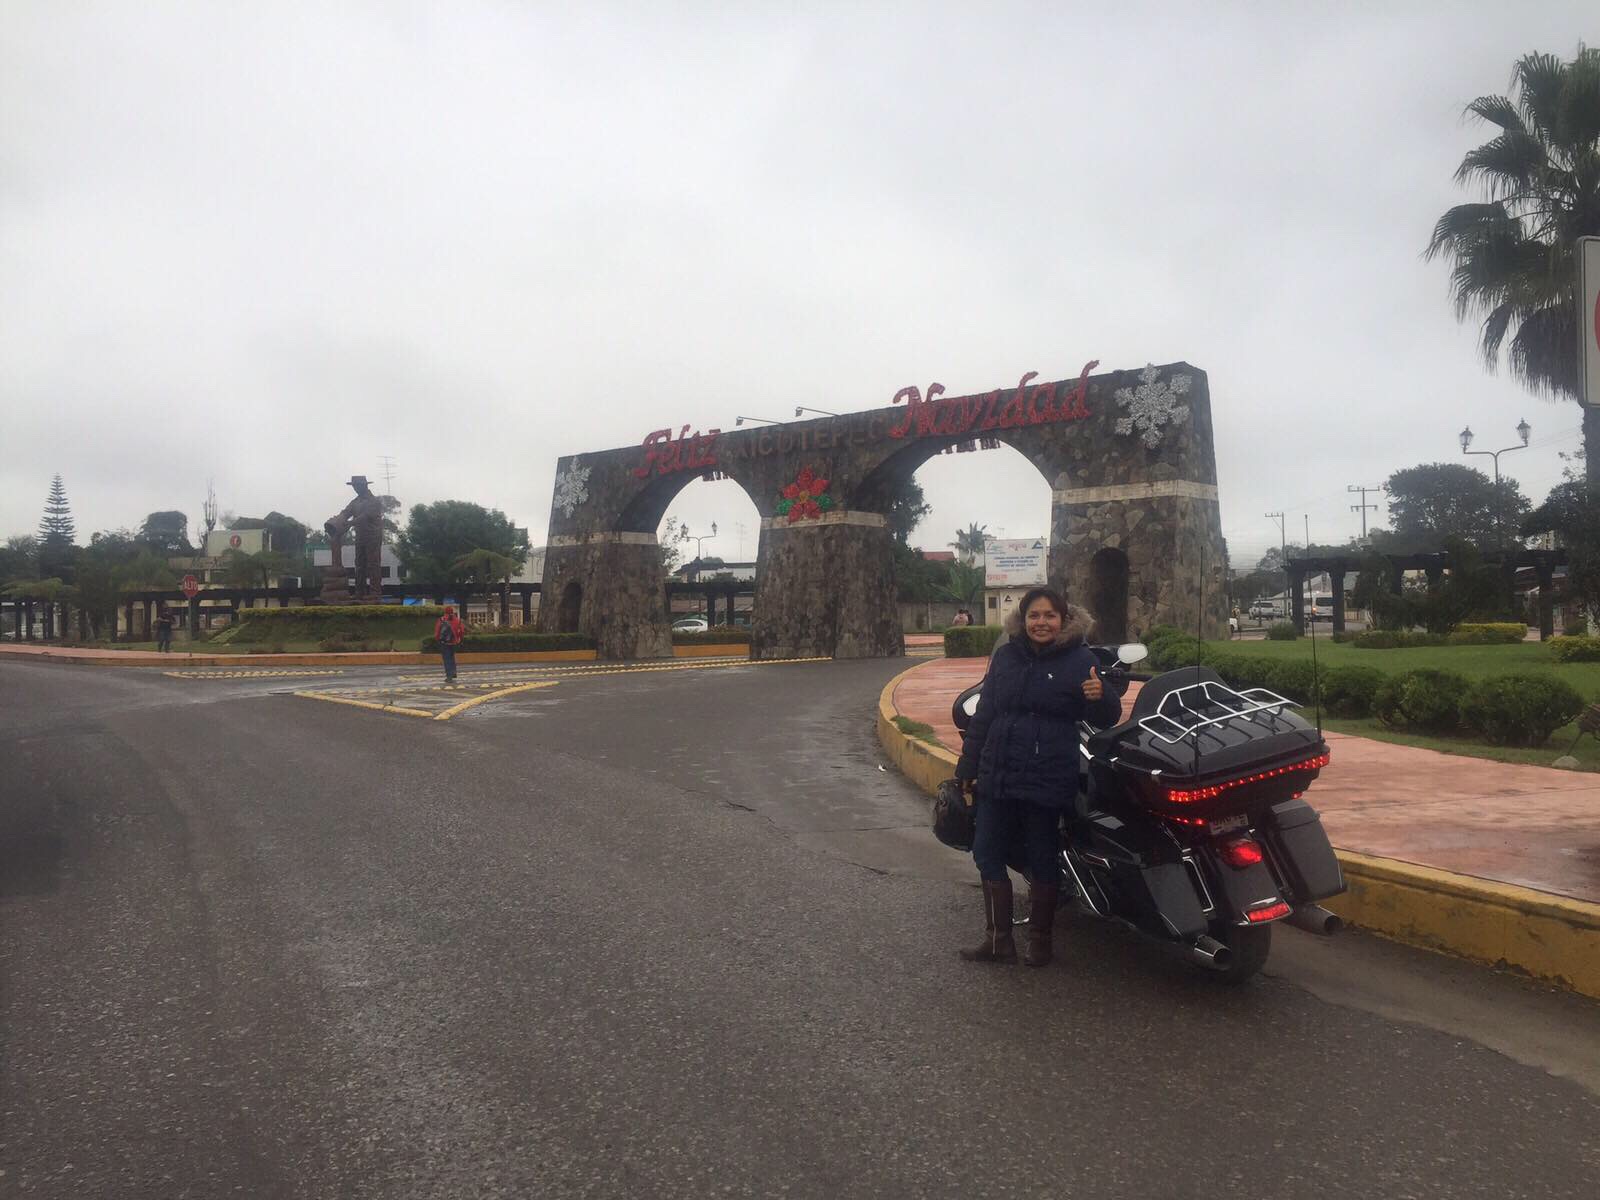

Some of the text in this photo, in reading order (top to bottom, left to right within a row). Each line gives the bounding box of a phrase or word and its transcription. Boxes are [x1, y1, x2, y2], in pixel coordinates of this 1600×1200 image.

[633, 360, 1099, 478] Feliz Navidad
[184, 579, 198, 590] ALTO
